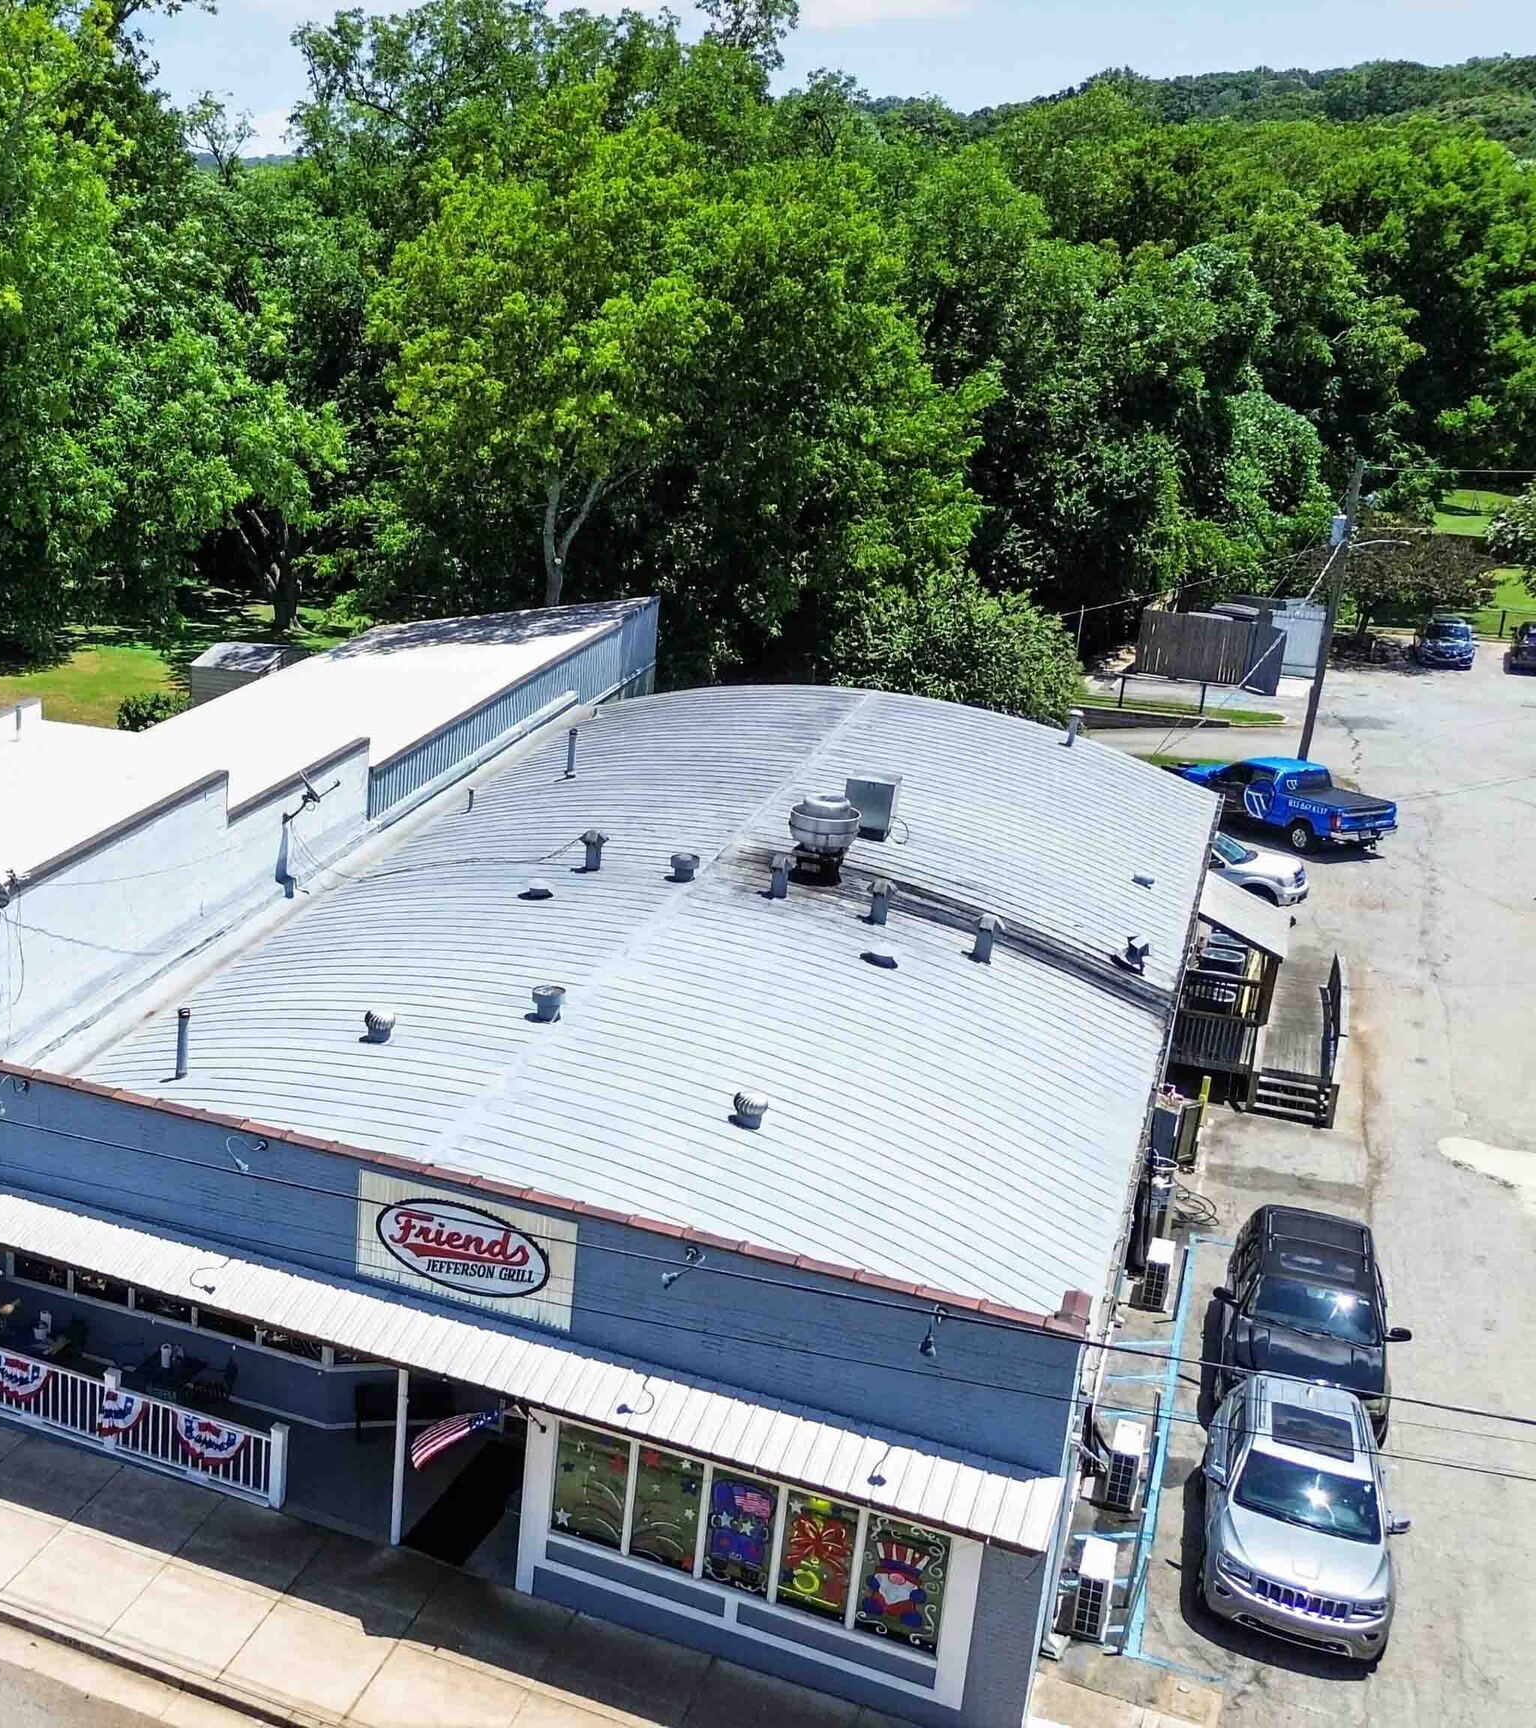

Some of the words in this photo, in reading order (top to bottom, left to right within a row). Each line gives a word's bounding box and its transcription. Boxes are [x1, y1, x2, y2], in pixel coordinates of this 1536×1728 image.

[389, 1211, 530, 1261] Friends
[425, 1258, 495, 1279] JEFFERSON
[499, 1267, 535, 1284] GRILL
